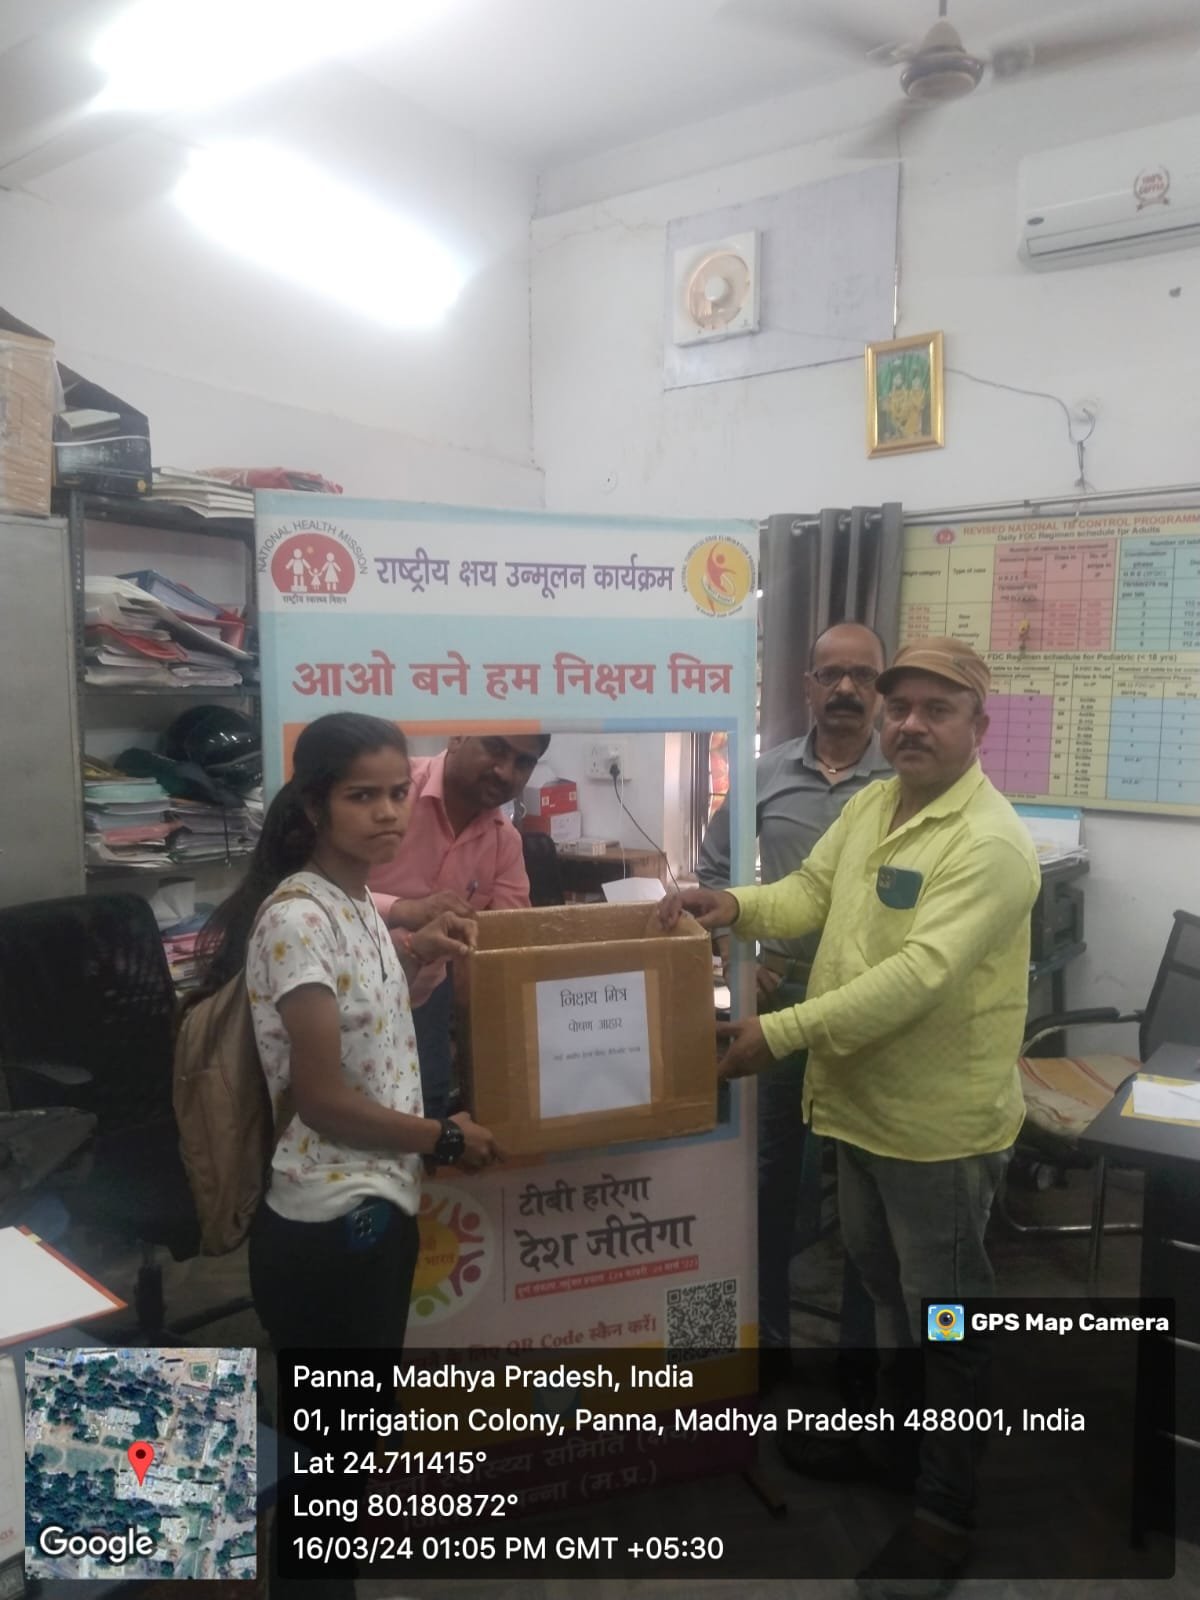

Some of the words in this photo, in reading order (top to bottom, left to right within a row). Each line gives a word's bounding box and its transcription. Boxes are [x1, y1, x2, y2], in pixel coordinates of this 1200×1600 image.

[963, 526, 1005, 536] REVISED
[1008, 521, 1057, 532] NATIONAL
[1079, 517, 1132, 529] CONTROL
[1038, 530, 1075, 541] Regimen
[1077, 528, 1115, 537] schedule
[1132, 526, 1160, 534] Adults
[256, 526, 292, 573] NATIONAL
[292, 520, 337, 535] HEALTH
[337, 530, 369, 575] MISSION
[374, 548, 449, 592] राष्ट्रीय
[459, 560, 497, 588] क्षय
[505, 562, 587, 599] उन्मूलन
[593, 553, 675, 592] कार्यक्रम
[1043, 653, 1081, 661] schedule
[1082, 653, 1094, 661] for
[1097, 653, 1134, 661] Pediatric
[292, 650, 396, 696] आओ
[408, 650, 471, 696] बने
[482, 663, 541, 700] हम
[553, 652, 656, 700] निक्षय
[667, 652, 733, 694] मित्र
[605, 984, 627, 1003] मित्र
[518, 1179, 577, 1217] टीबी
[582, 1173, 653, 1212] हारेगा
[513, 1229, 579, 1273] देश
[586, 1212, 697, 1260] जीतेगा
[540, 1329, 584, 1349] Code
